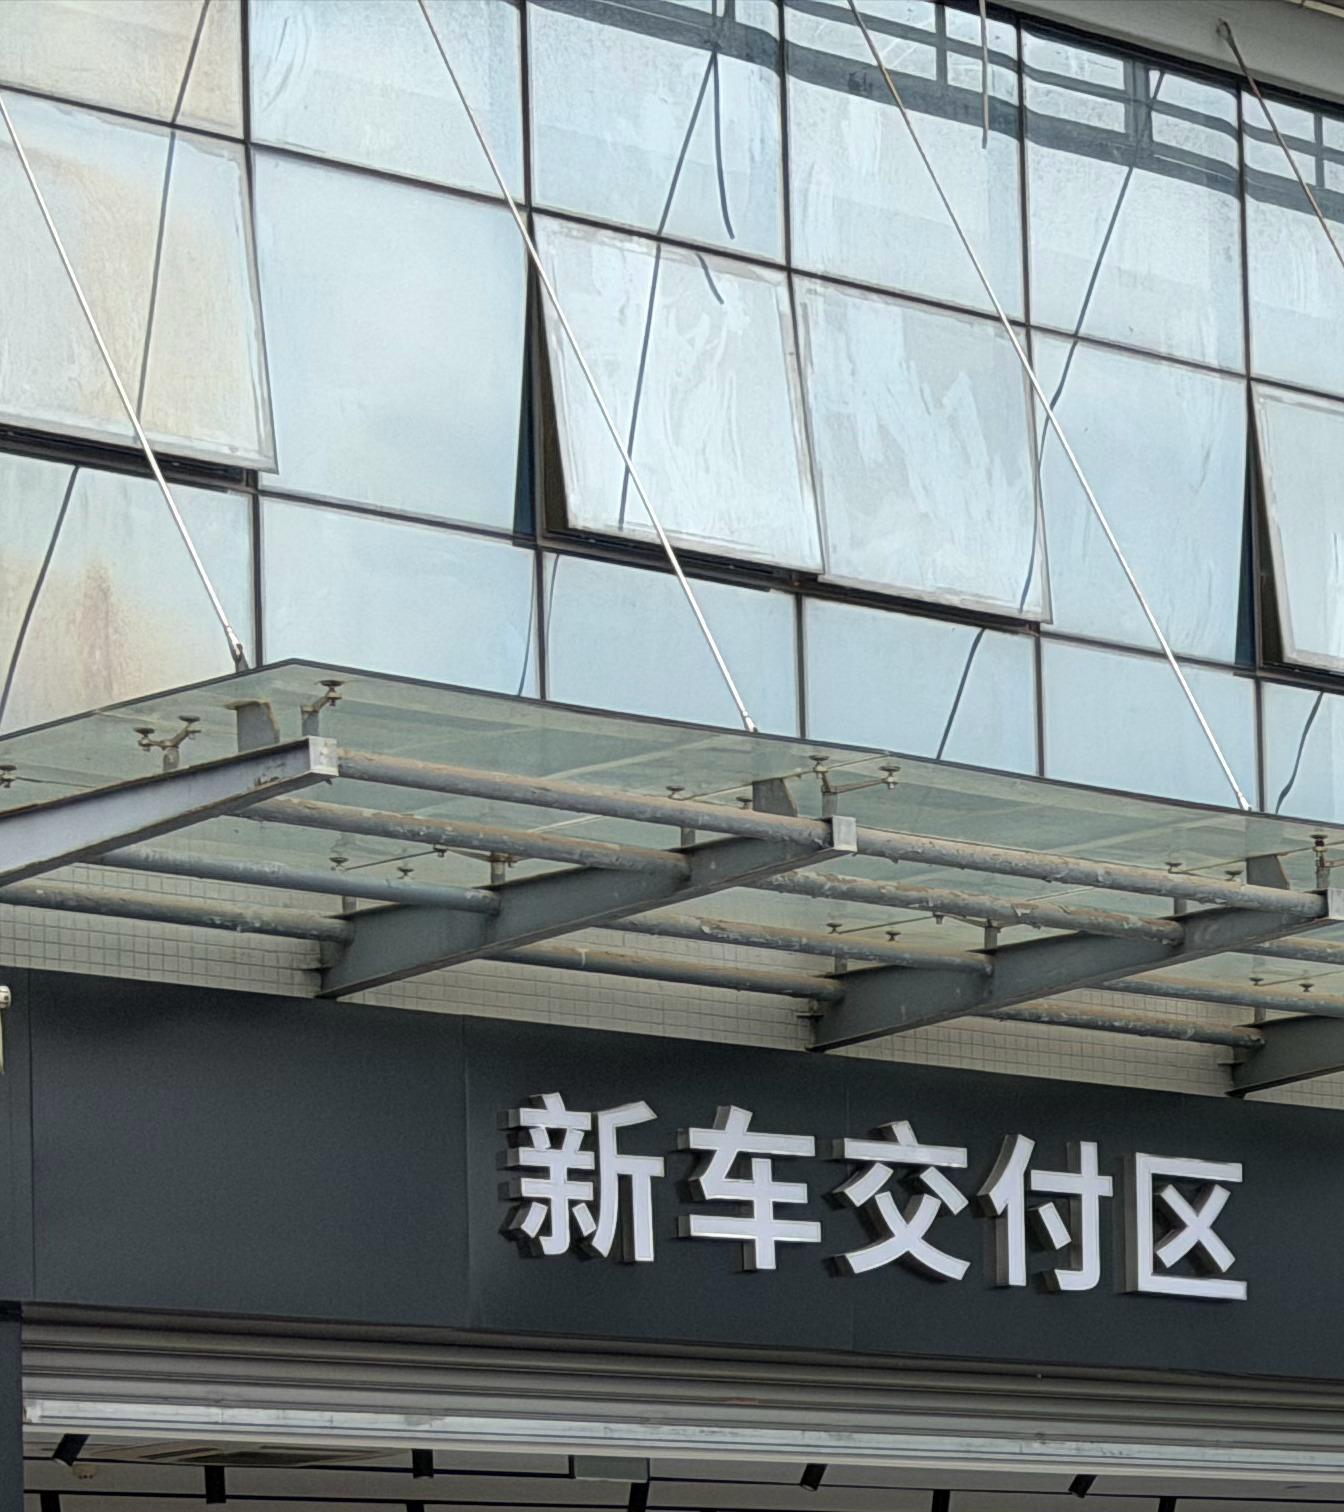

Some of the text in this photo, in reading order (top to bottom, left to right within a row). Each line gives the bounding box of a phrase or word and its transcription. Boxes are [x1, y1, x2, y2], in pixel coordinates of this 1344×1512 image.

[503, 1092, 1248, 1301] 新车交付区
